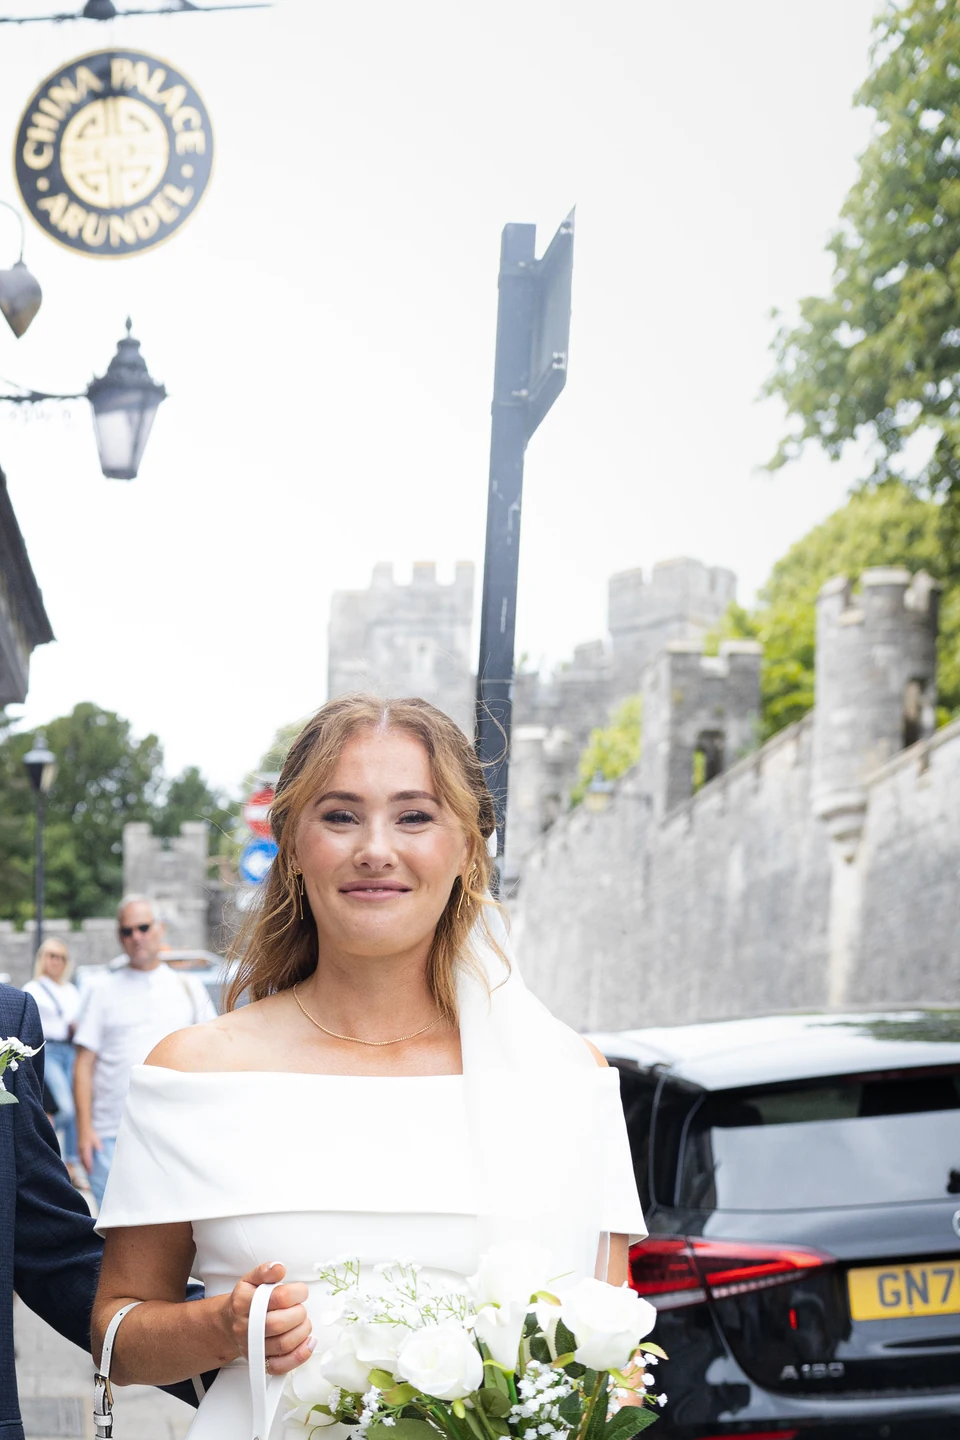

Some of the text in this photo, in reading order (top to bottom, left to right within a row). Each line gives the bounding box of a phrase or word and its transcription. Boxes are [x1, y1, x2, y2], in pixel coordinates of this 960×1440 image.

[23, 57, 206, 170] CHINA PALACE
[37, 183, 195, 248] ARUNDEL
[877, 1267, 960, 1308] GN7
